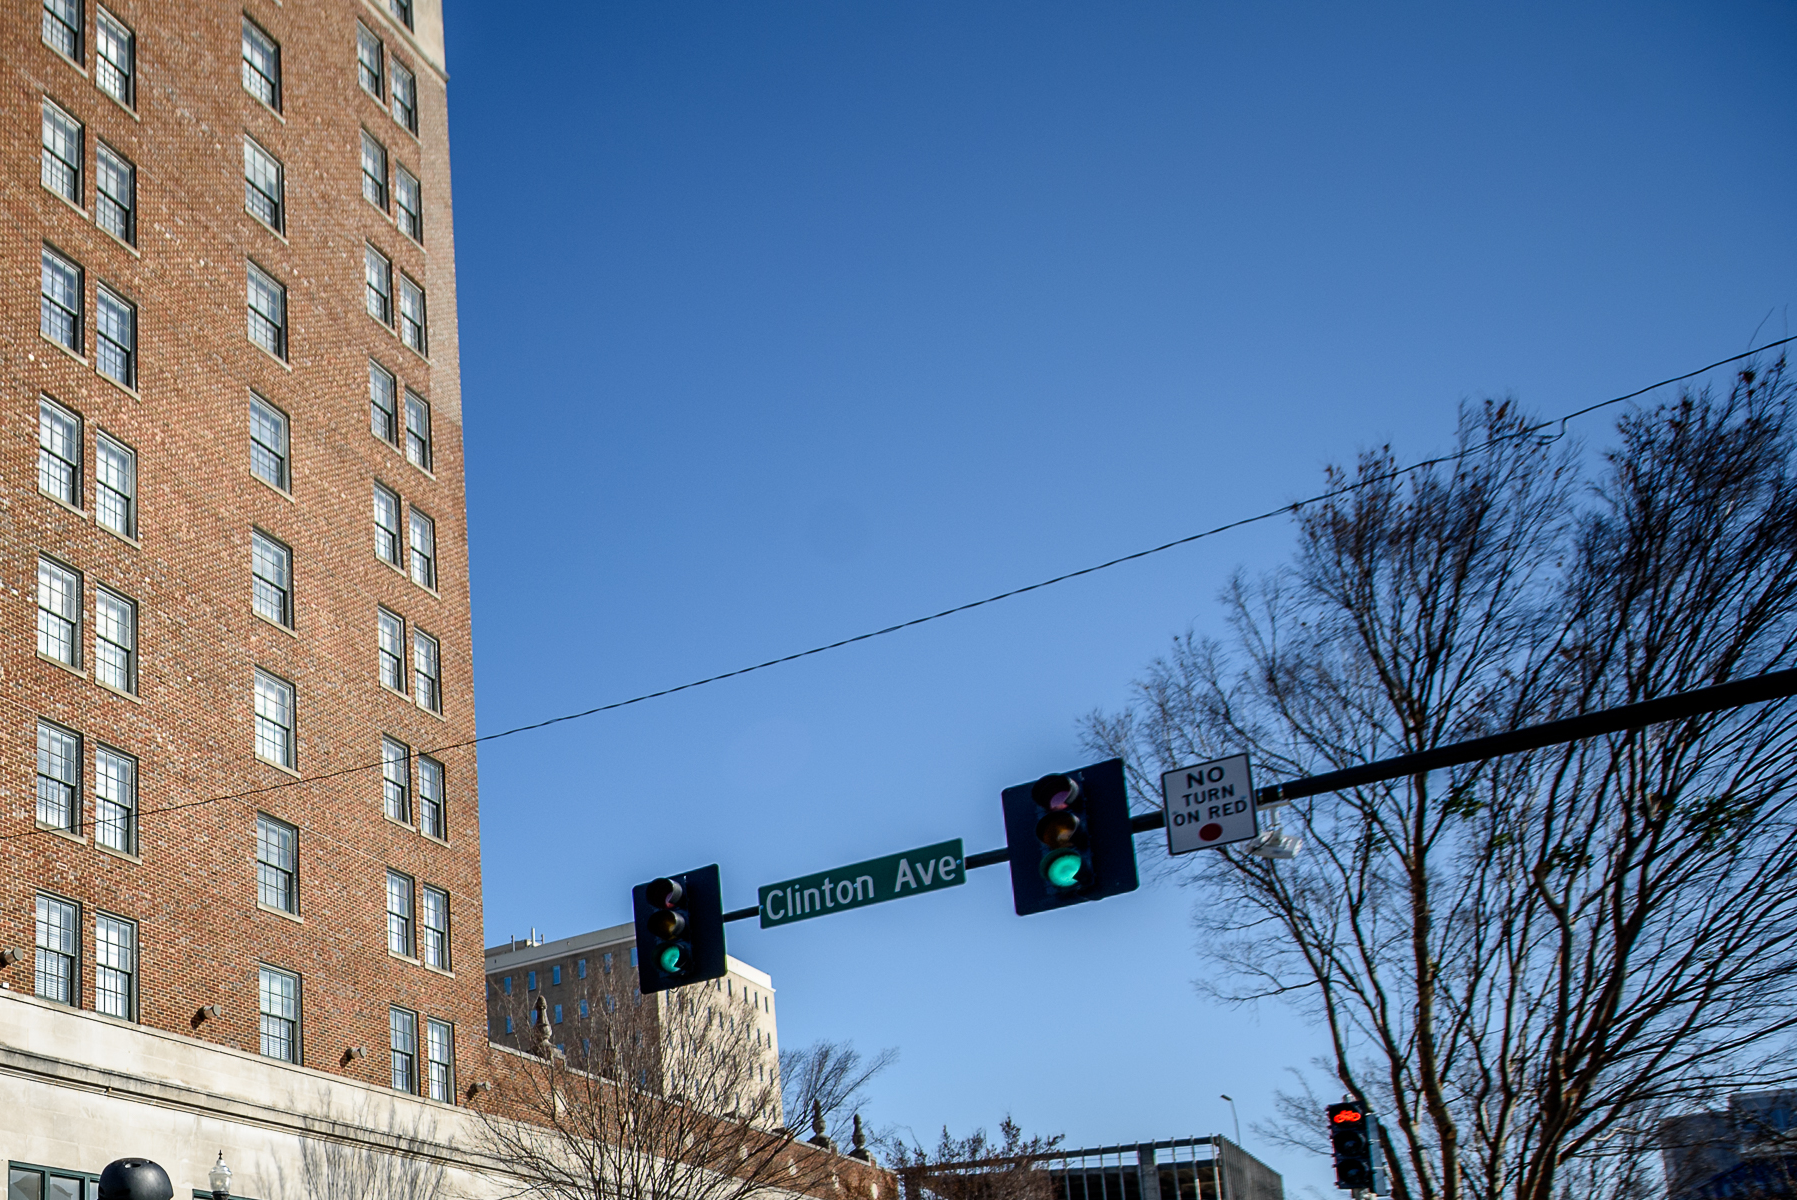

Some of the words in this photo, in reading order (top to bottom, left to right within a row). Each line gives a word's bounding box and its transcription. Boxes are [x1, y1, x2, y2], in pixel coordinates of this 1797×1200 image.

[1186, 766, 1225, 789] NO
[1182, 783, 1235, 807] TURN
[1173, 809, 1201, 826] ON
[1208, 799, 1248, 820] RED
[766, 874, 875, 920] Clinton
[894, 855, 957, 893] Ave
